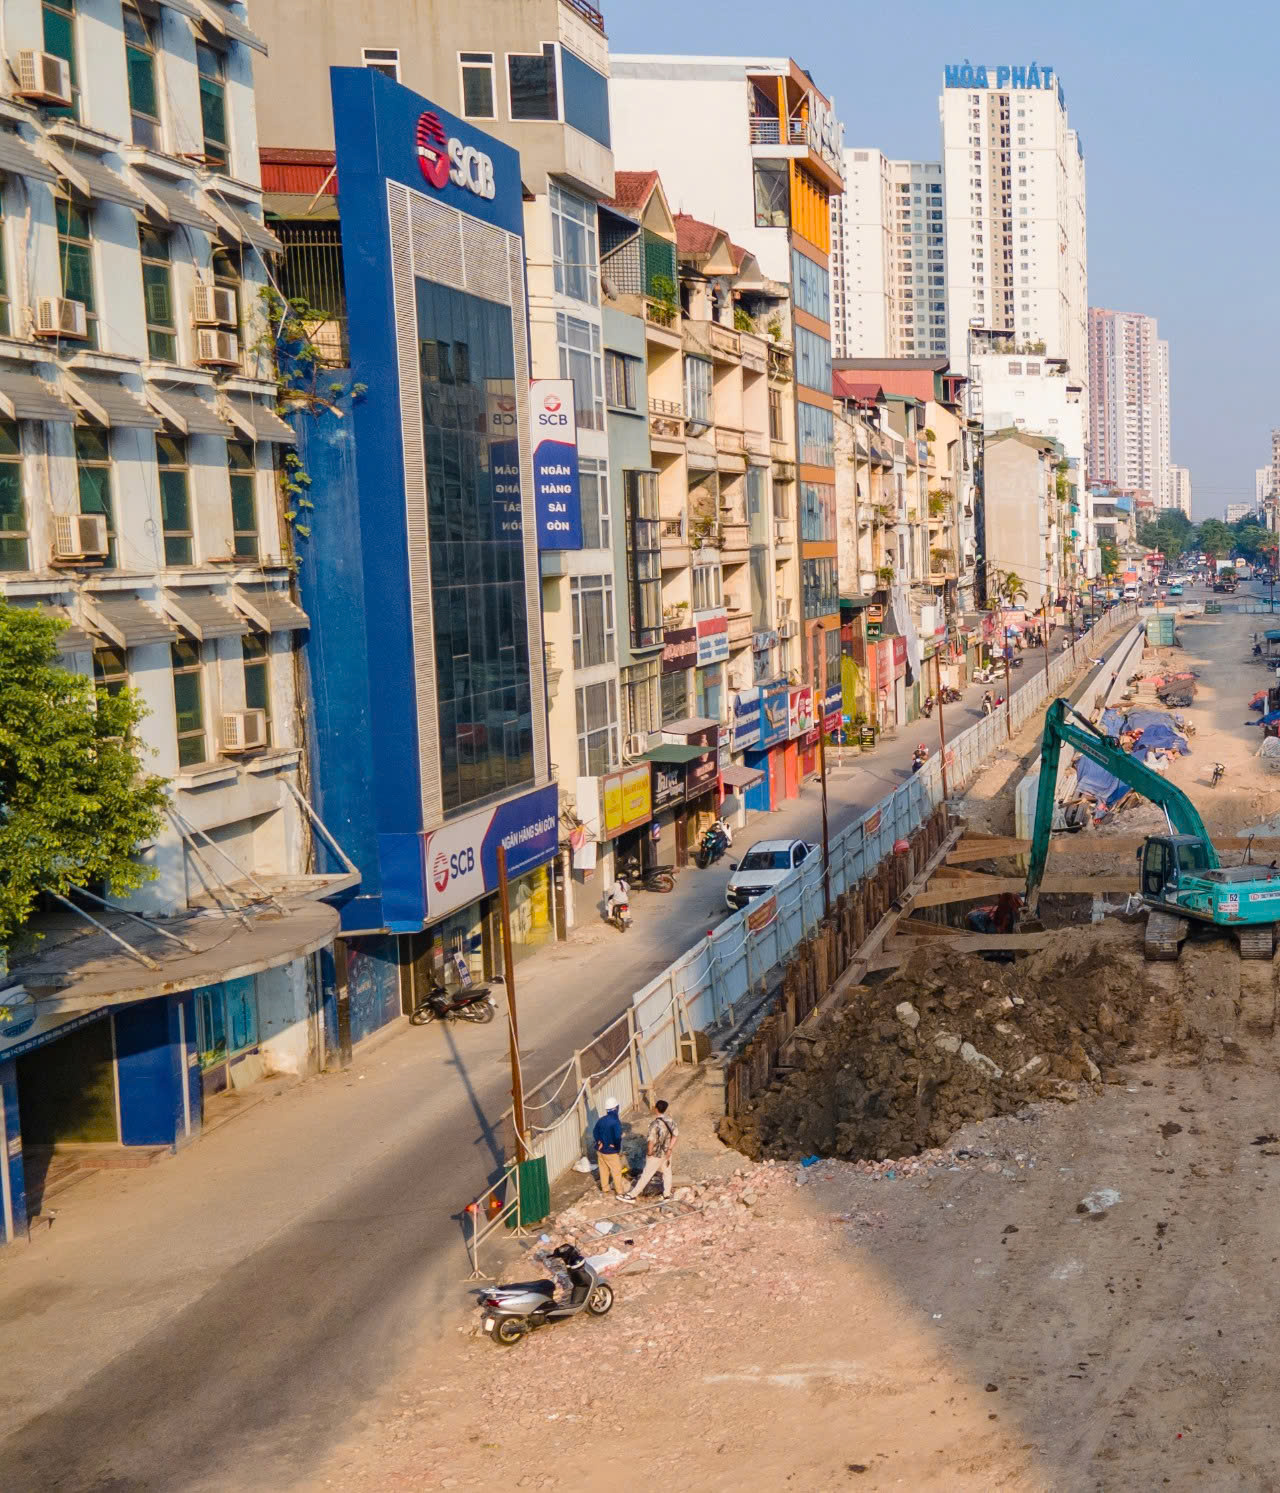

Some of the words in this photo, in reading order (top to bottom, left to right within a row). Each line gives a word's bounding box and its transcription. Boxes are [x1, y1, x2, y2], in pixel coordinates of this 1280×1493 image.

[945, 58, 989, 89] HÒA
[996, 60, 1053, 91] PHÁT
[448, 137, 496, 200] SCB
[538, 414, 568, 425] SCB
[540, 465, 570, 475] NGÂN
[541, 484, 571, 494] HÀNG
[548, 502, 566, 512] SÀI
[546, 520, 569, 531] GÒN
[502, 831, 519, 850] NGÂN
[519, 825, 534, 844] HÀNG
[534, 819, 544, 836] SÀI
[544, 815, 555, 832] GÒN
[450, 847, 474, 879] SCB
